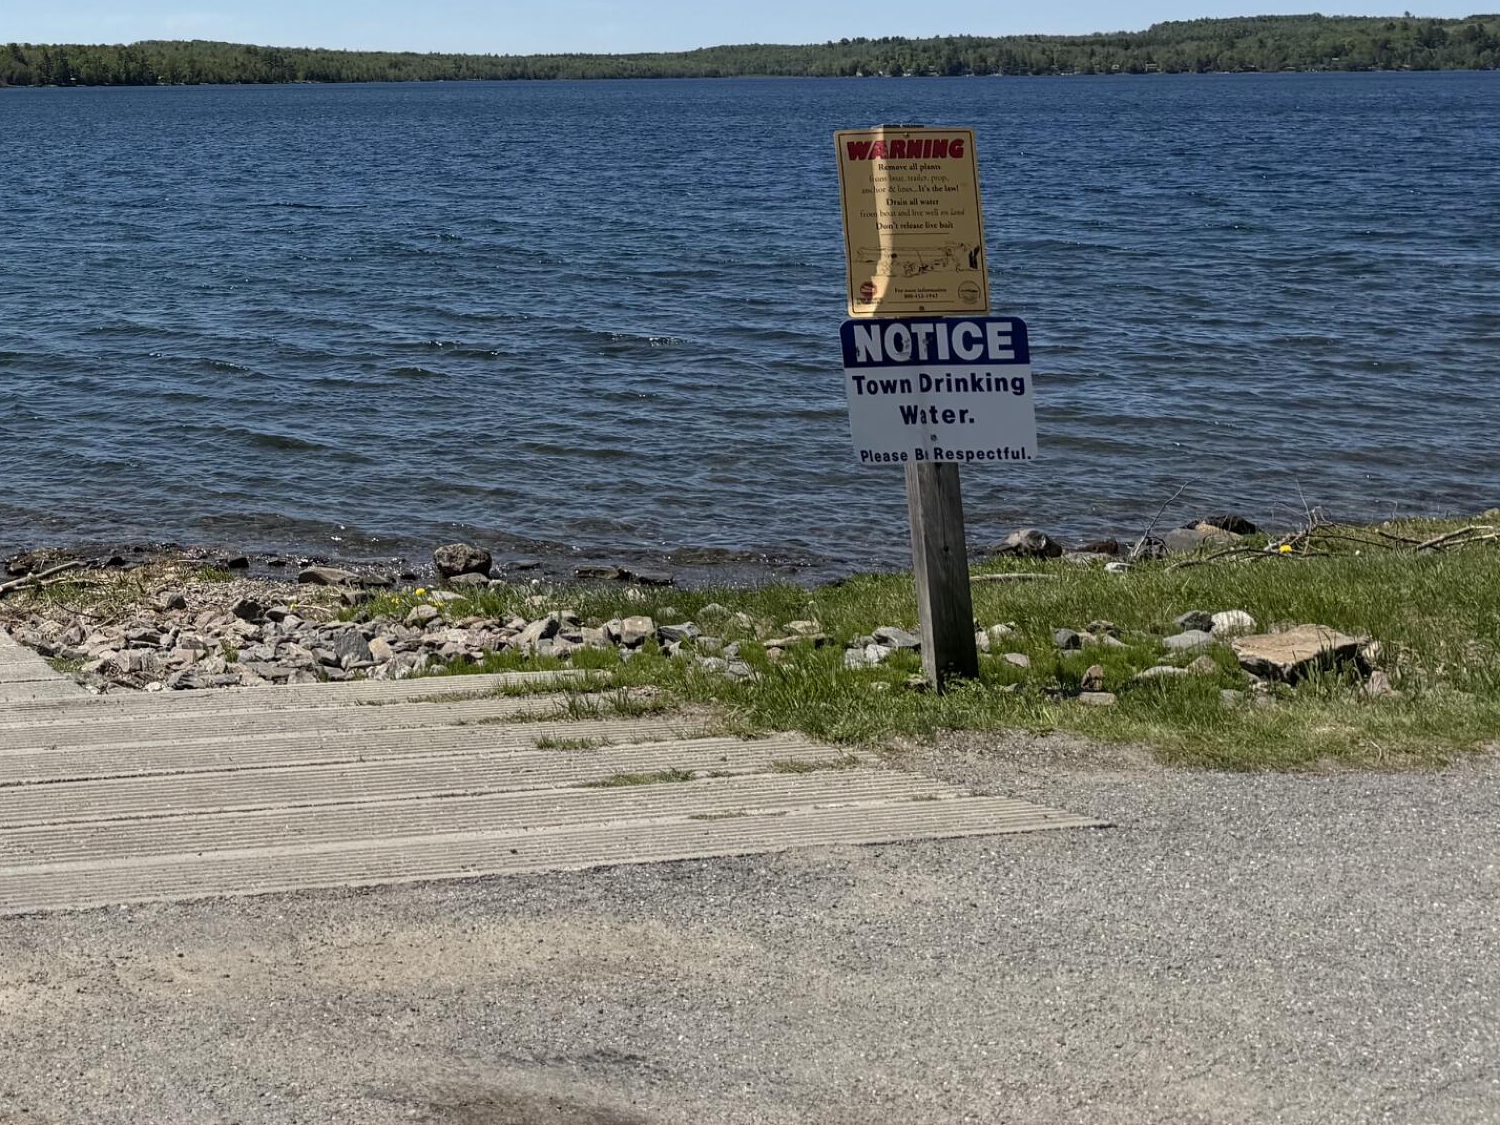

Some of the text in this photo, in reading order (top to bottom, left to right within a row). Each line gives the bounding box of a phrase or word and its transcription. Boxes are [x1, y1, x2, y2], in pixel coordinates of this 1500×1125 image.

[847, 138, 965, 161] WARNING
[878, 162, 941, 172] Remove all plants
[932, 184, 943, 192] the
[886, 198, 908, 206] Drain
[909, 197, 918, 206] all
[860, 209, 878, 218] from
[880, 208, 897, 217] boat
[898, 208, 911, 216] and
[876, 220, 954, 230] Don't release live bait
[853, 321, 1016, 363] NOTICE
[852, 372, 1026, 396] Town Drinking
[899, 405, 975, 425] Water.
[860, 449, 909, 463] Please
[934, 446, 1032, 462] Respectful.
